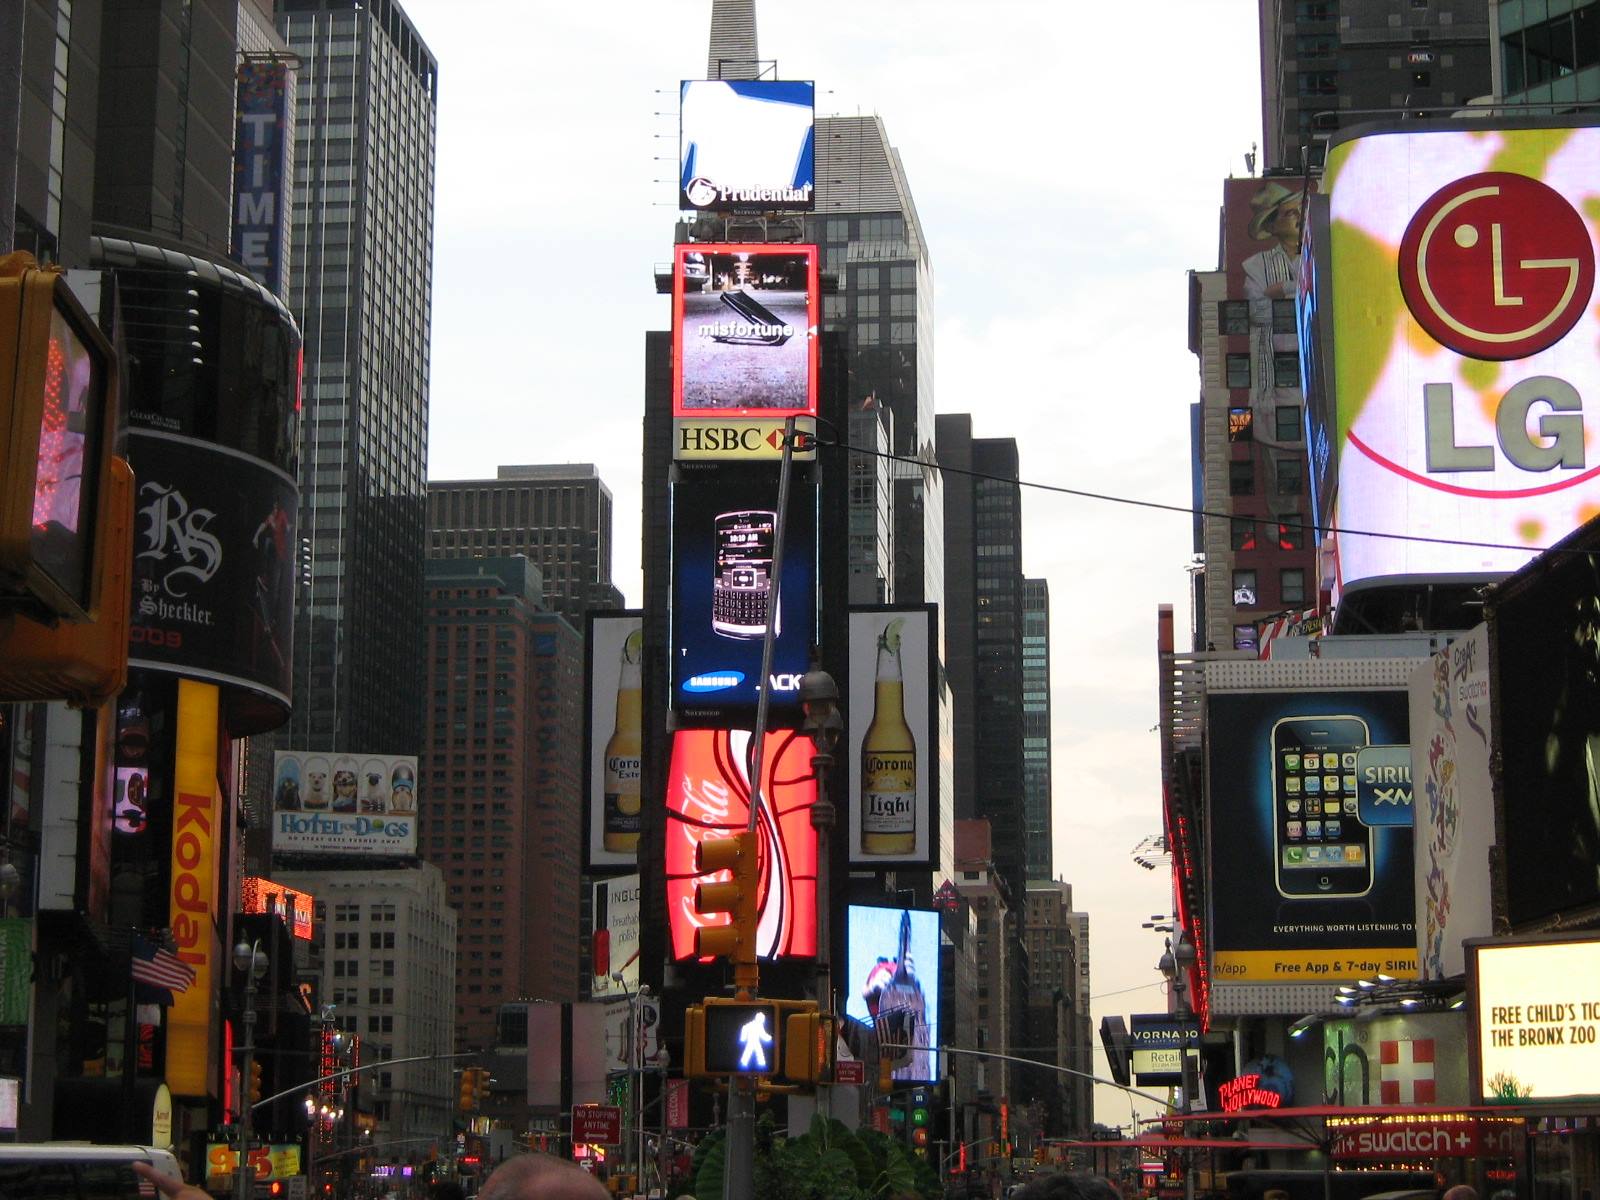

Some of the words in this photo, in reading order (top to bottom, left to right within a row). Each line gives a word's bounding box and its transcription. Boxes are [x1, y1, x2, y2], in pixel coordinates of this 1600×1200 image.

[719, 183, 810, 202] Prudential
[698, 321, 795, 337] misfortune
[1423, 375, 1586, 473] LG
[680, 428, 761, 451] HSBC
[139, 595, 212, 625] Sheckler
[690, 676, 738, 686] SAMSUNG
[618, 929, 637, 946] polish
[1273, 925, 1325, 933] EVERYTHING
[1326, 924, 1355, 932] WORTH
[1357, 923, 1400, 931] LISTENING
[1274, 962, 1301, 973] Free
[1306, 961, 1329, 974] App
[1333, 962, 1342, 971] &
[1347, 960, 1381, 974] 7-day
[1492, 1006, 1522, 1025] FREE
[1527, 1003, 1576, 1023] CHILD'S
[1491, 1028, 1515, 1048] THE
[1519, 1026, 1565, 1047] BRONX
[1569, 1025, 1596, 1044] ZOO
[1218, 1074, 1260, 1107] PLANET
[1225, 1089, 1280, 1112] HOLLYWOOD
[577, 1110, 586, 1119] NO
[588, 1111, 617, 1119] STOPPING
[583, 1121, 611, 1130] ANYTIME
[1359, 1126, 1451, 1153] swatch
